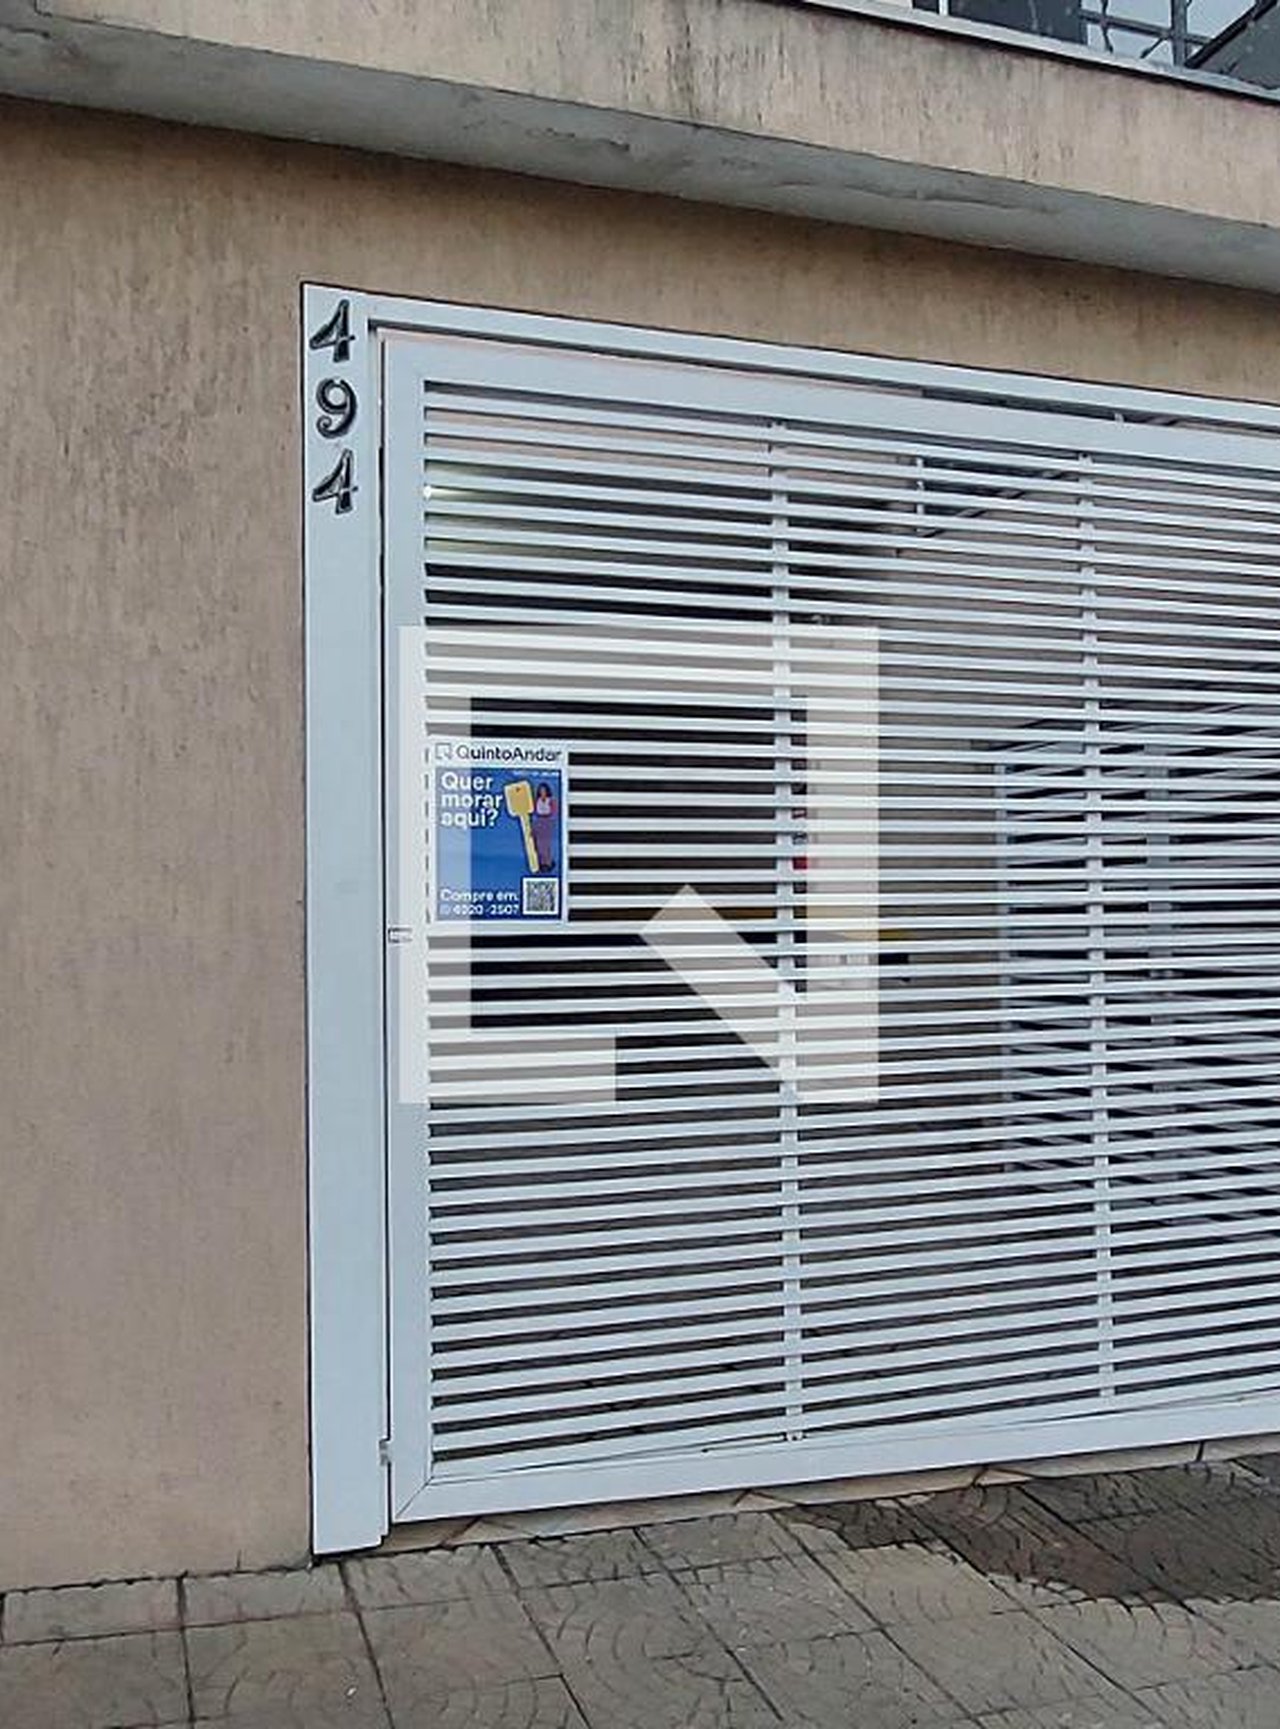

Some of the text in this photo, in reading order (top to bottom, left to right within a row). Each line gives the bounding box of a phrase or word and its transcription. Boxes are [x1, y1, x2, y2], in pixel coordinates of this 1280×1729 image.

[310, 299, 357, 515] 494
[456, 744, 561, 762] QuintoAndar
[441, 772, 493, 790] Quer
[441, 793, 503, 807] morar
[441, 809, 499, 829] aqui?
[440, 888, 494, 903] Compre
